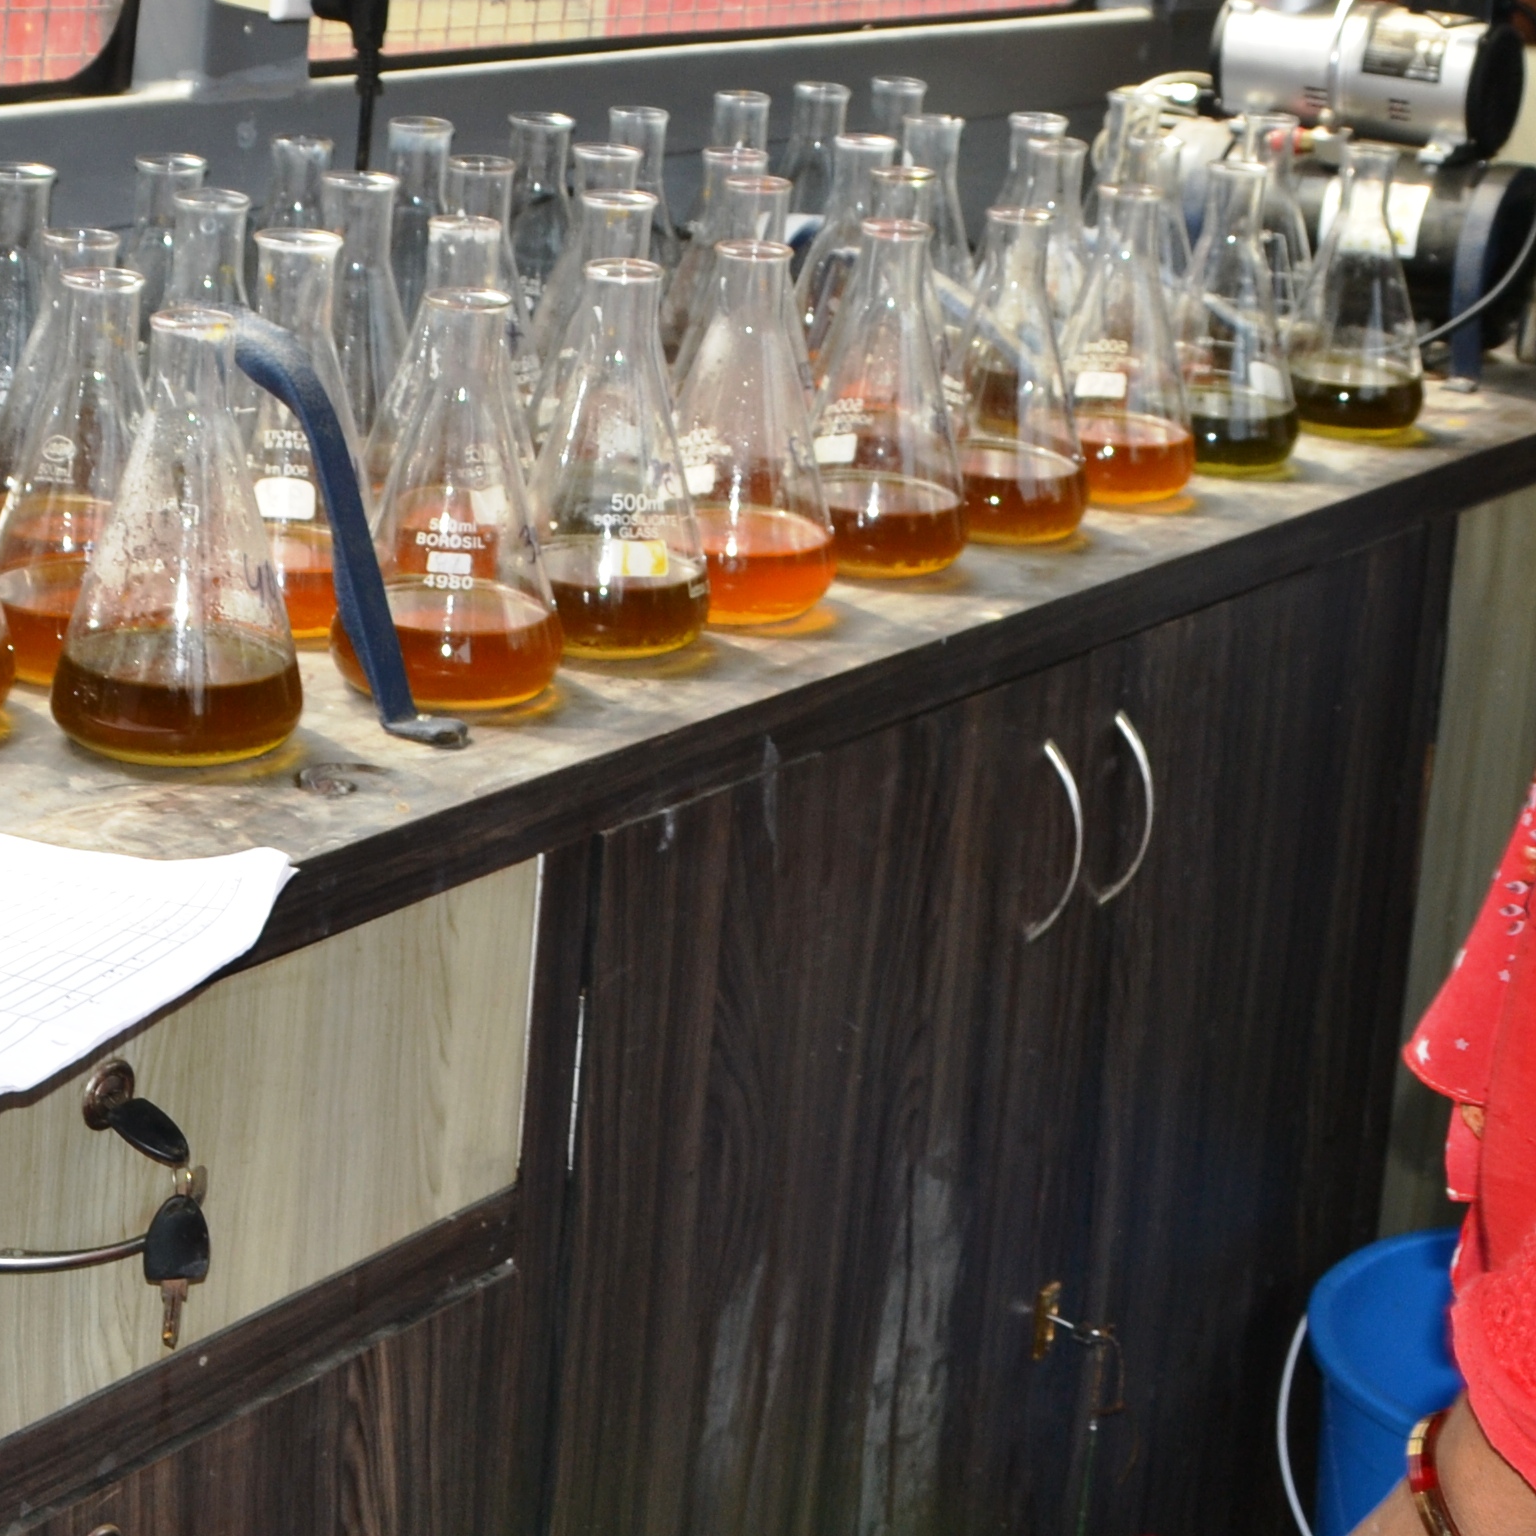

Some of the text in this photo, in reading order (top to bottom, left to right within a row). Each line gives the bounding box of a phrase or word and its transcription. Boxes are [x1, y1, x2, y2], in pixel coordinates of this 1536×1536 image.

[428, 517, 478, 533] 50ml
[593, 514, 678, 527] BOROSILICATE
[415, 531, 486, 549] BOROSIL
[619, 526, 658, 539] GLASS
[423, 573, 473, 590] 4980
